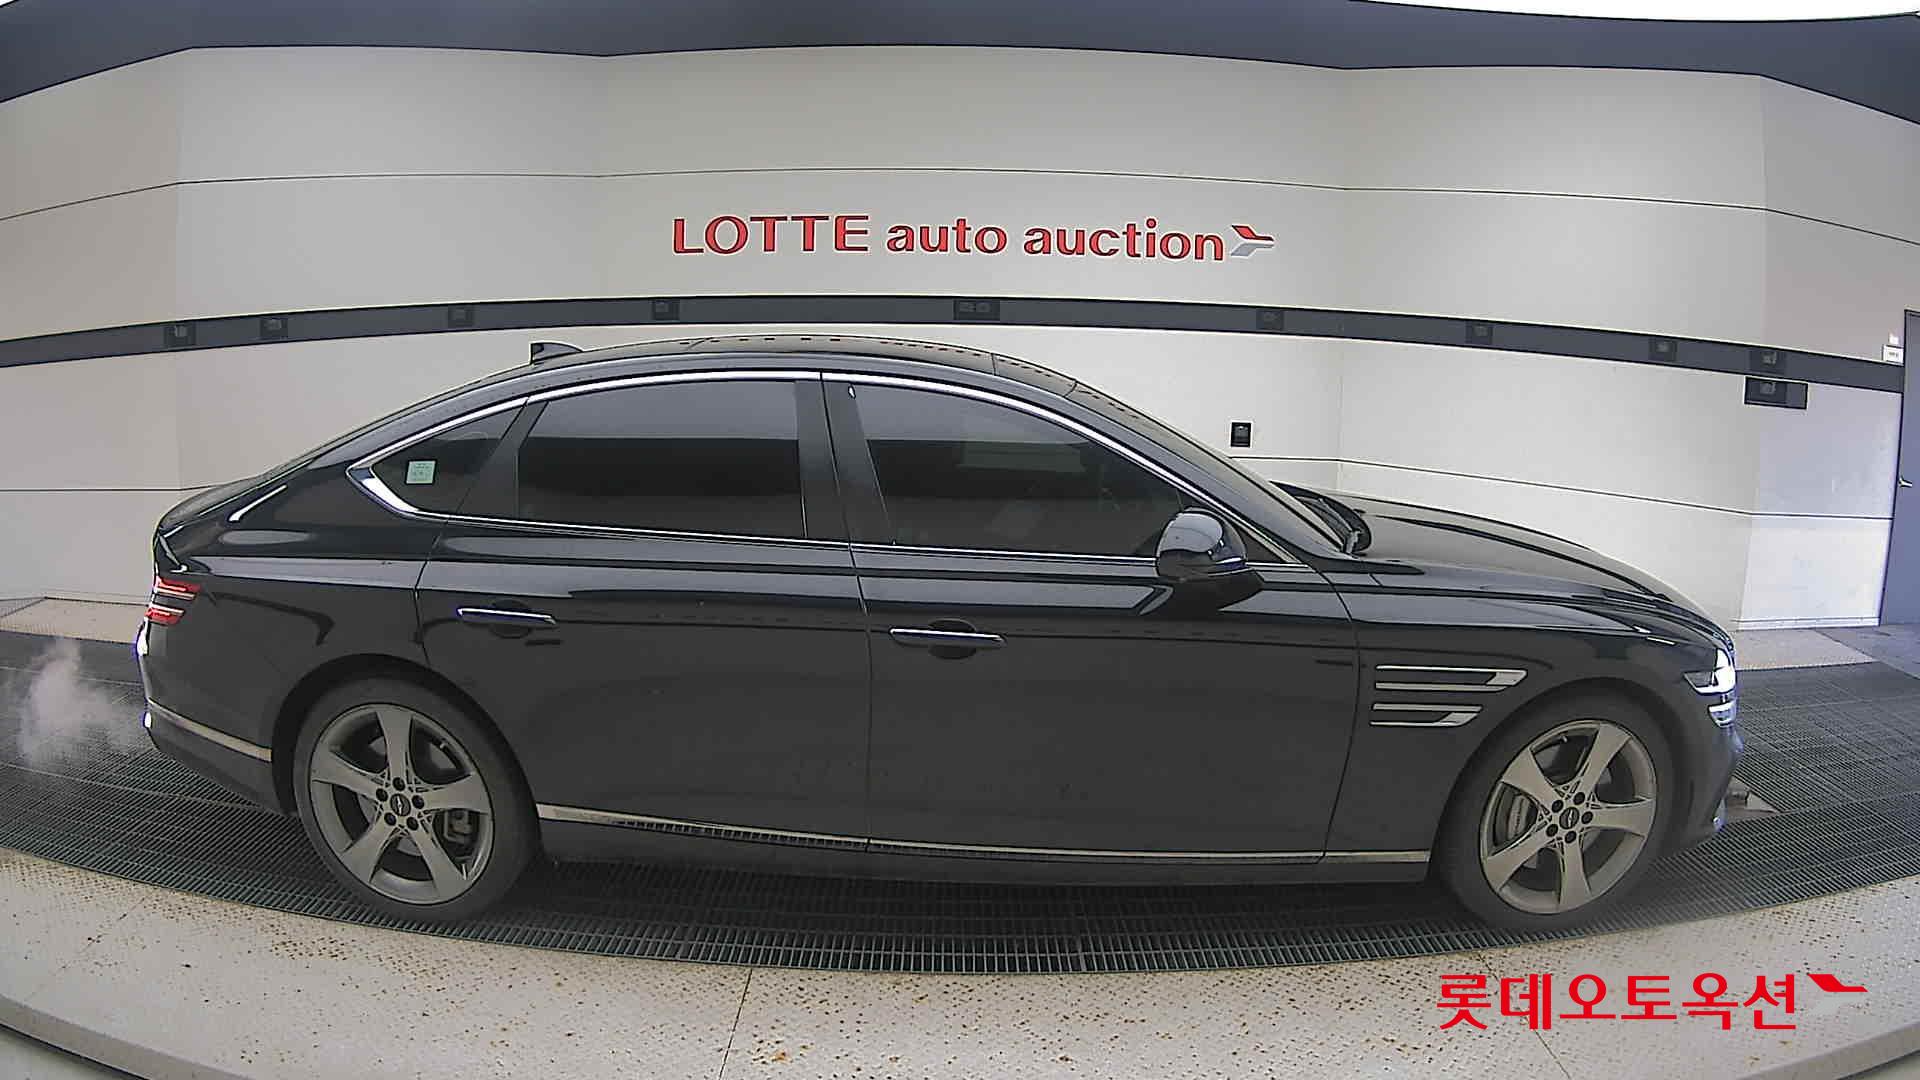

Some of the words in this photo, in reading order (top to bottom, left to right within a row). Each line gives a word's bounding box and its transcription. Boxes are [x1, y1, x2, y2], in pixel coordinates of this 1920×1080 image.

[672, 214, 869, 254] LOTTE
[886, 217, 1008, 254] auto
[1023, 219, 1225, 261] auction
